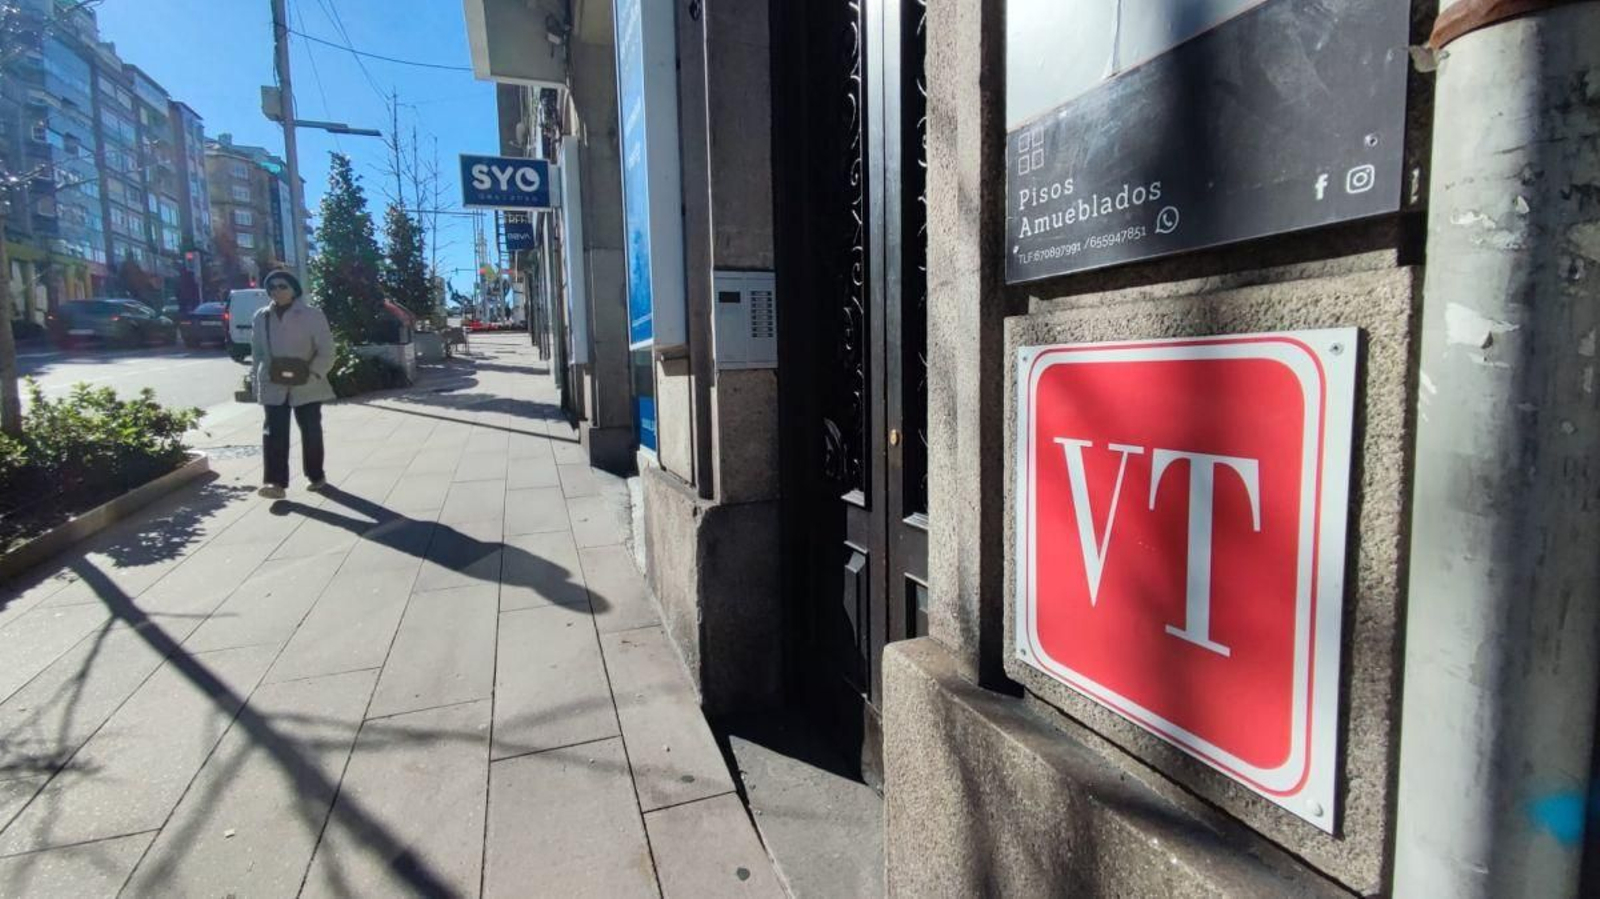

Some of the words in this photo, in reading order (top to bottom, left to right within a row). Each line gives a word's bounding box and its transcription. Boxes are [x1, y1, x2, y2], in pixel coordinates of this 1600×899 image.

[471, 164, 540, 193] SYO
[1018, 178, 1075, 211] Pisos
[1018, 181, 1163, 239] Amueblados
[1053, 437, 1261, 658] VT
